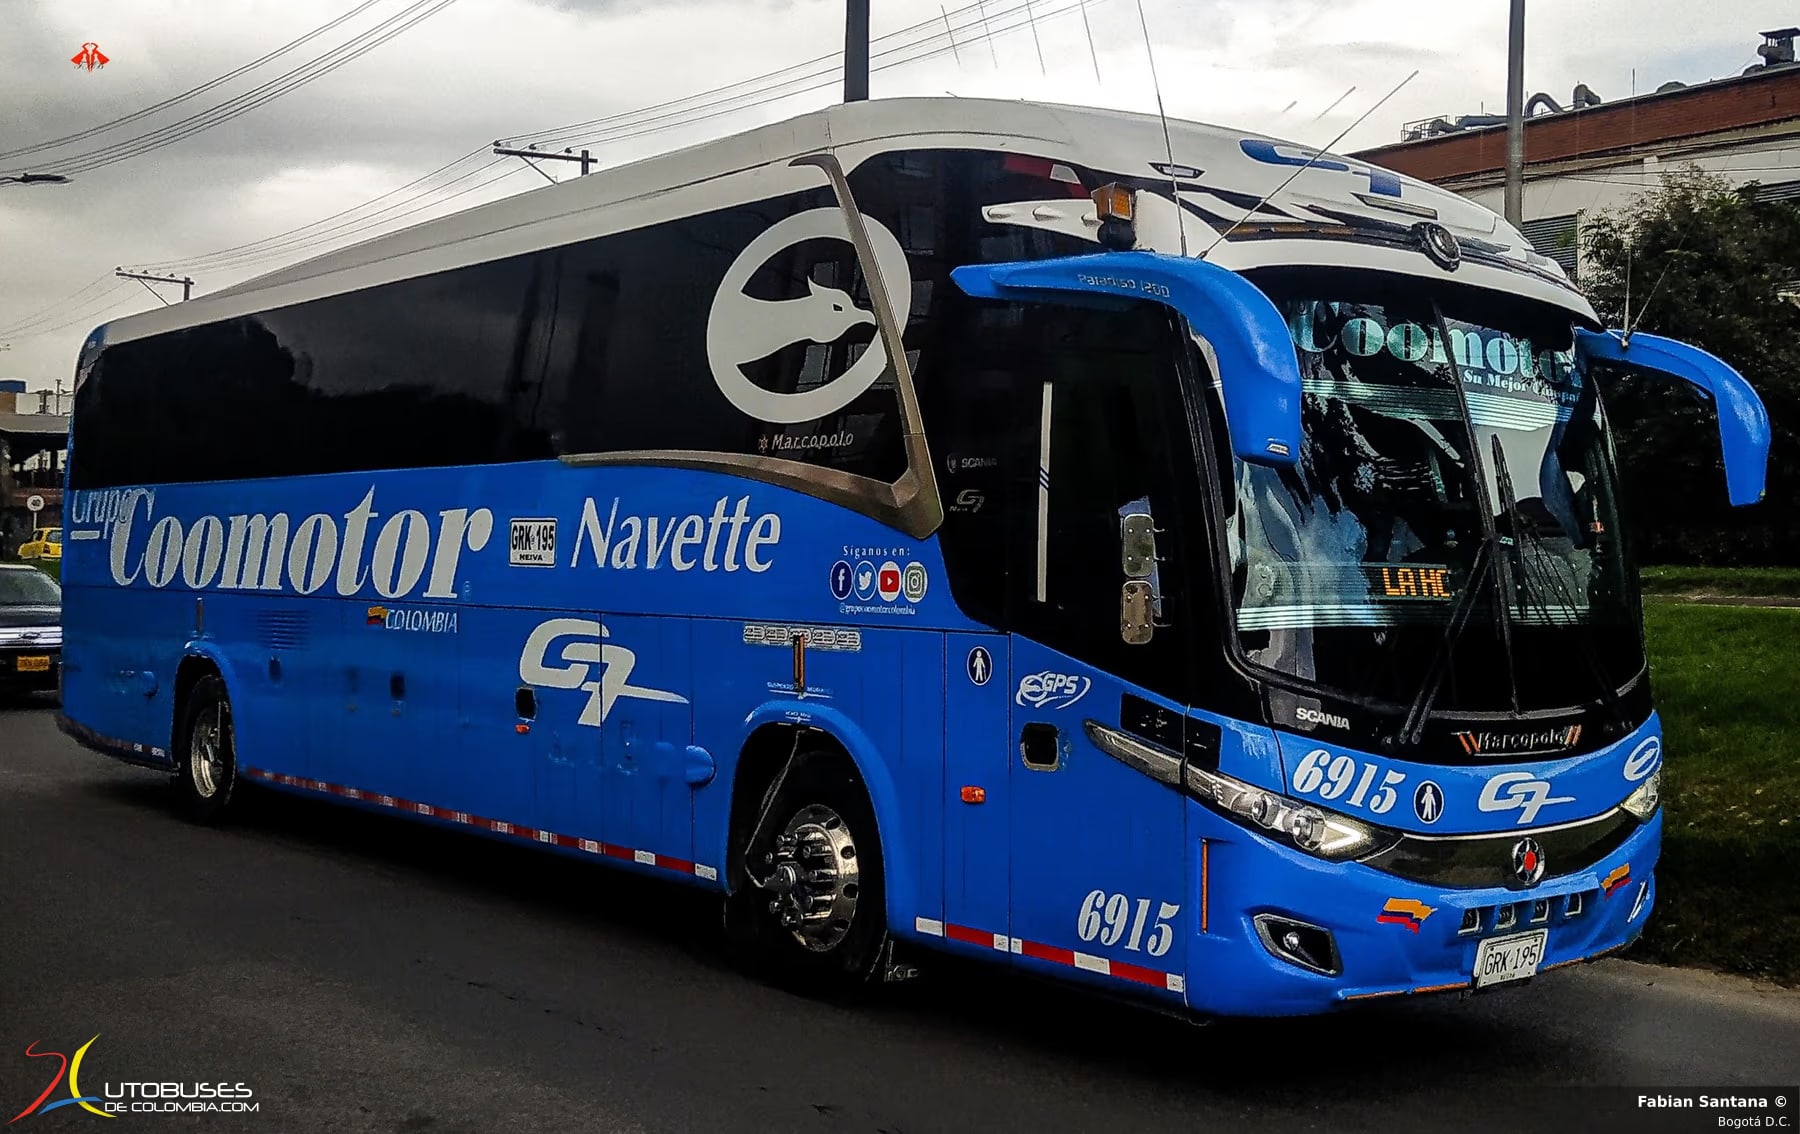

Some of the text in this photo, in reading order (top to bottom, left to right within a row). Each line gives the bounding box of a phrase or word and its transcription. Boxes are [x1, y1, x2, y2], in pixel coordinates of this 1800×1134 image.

[1140, 280, 1170, 298] 1200
[1463, 369, 1483, 385] Su
[1486, 373, 1528, 393] Mejor
[771, 430, 854, 450] Marcopolo
[72, 489, 132, 540] Grupo
[110, 484, 494, 599] Coomotor
[571, 495, 782, 573] Navette
[519, 553, 543, 561] NEIVA
[1382, 567, 1417, 596] LA
[385, 608, 458, 634] COLOMBIA
[1042, 673, 1079, 694] GPS
[1296, 707, 1351, 730] SCANIA
[1478, 728, 1566, 750] Marcopolo
[1292, 748, 1406, 815] 6915
[1077, 888, 1180, 957] 6915
